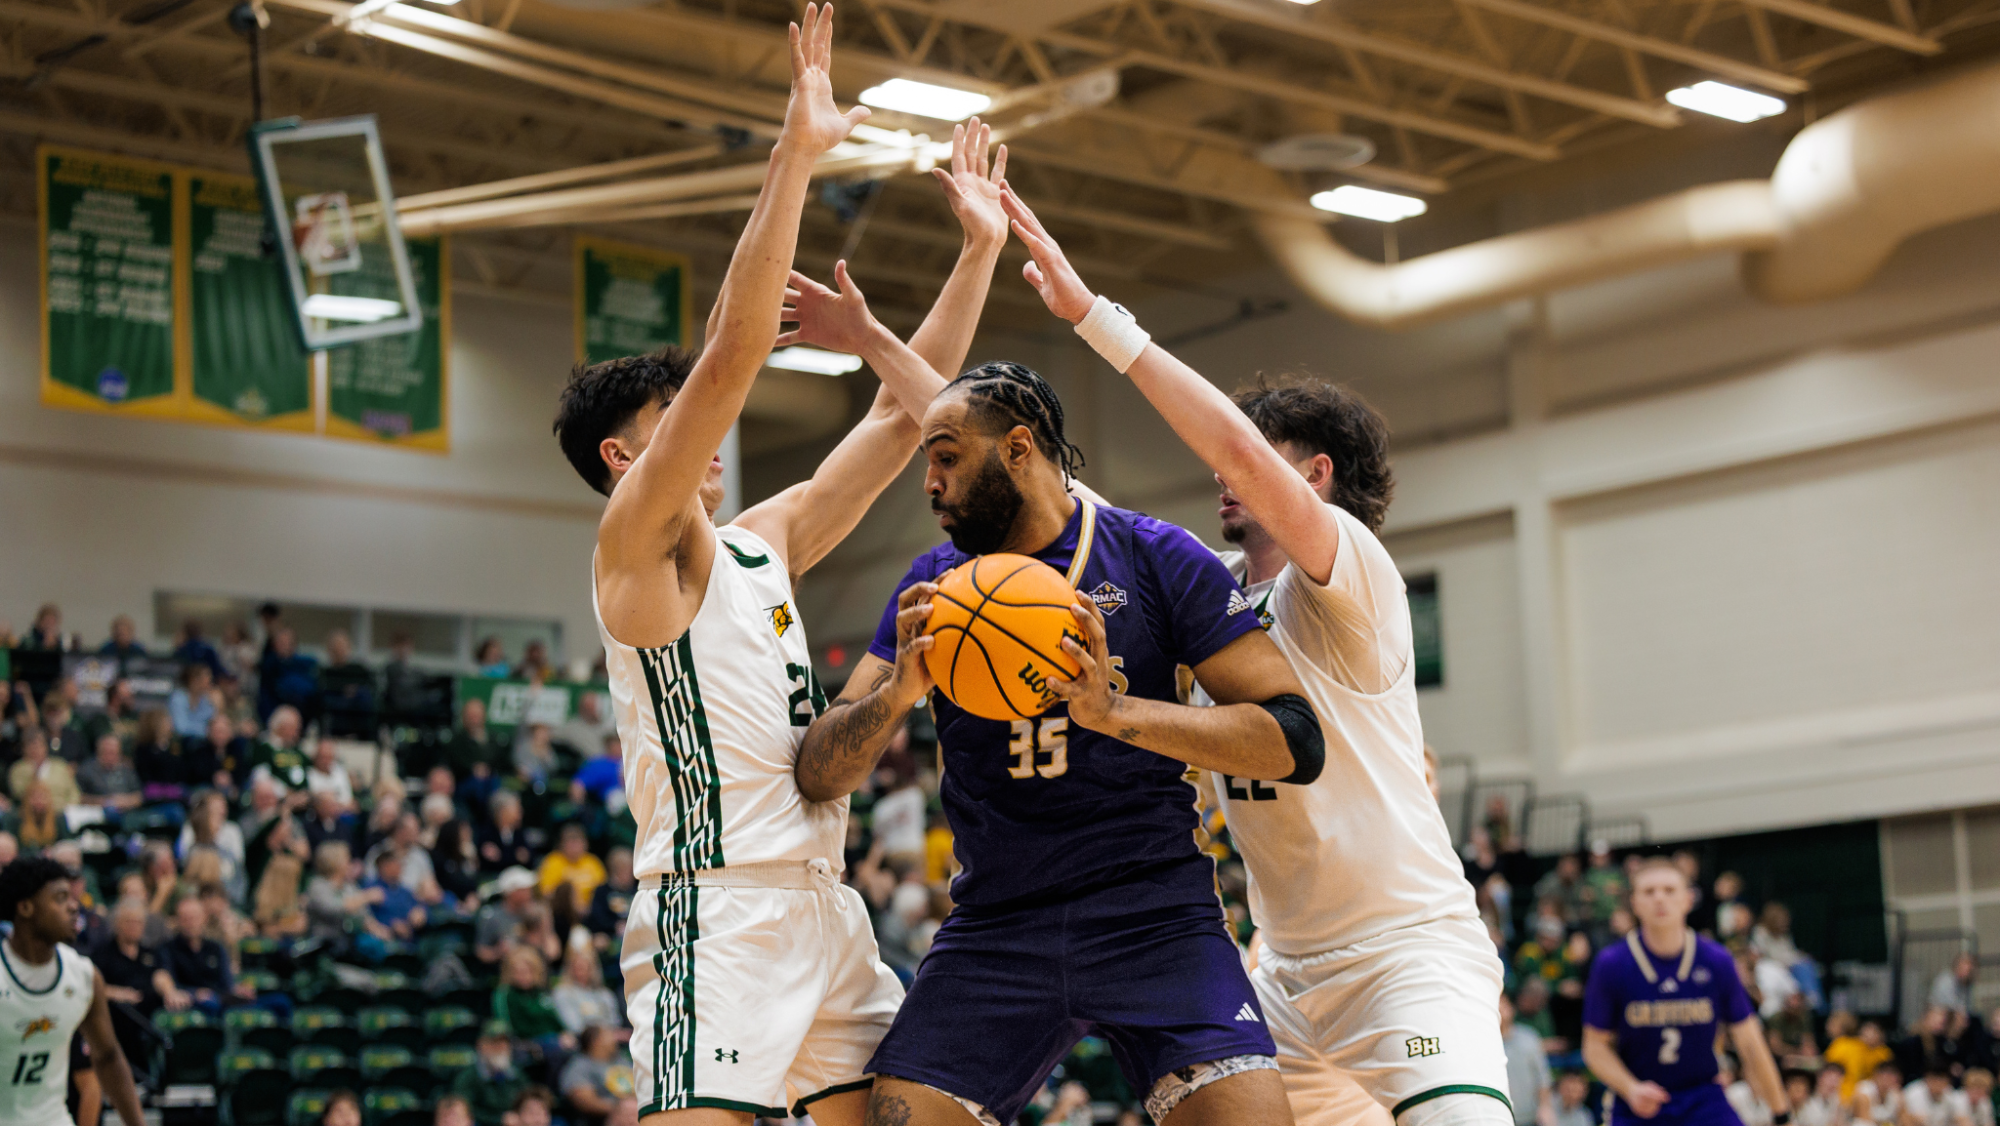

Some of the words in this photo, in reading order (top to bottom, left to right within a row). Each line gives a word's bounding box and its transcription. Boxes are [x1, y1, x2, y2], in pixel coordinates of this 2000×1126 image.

[1092, 593, 1124, 604] RMAC
[1007, 716, 1069, 779] 35
[1405, 1036, 1440, 1058] BH
[1658, 1028, 1682, 1065] 2
[12, 1053, 50, 1085] 12
